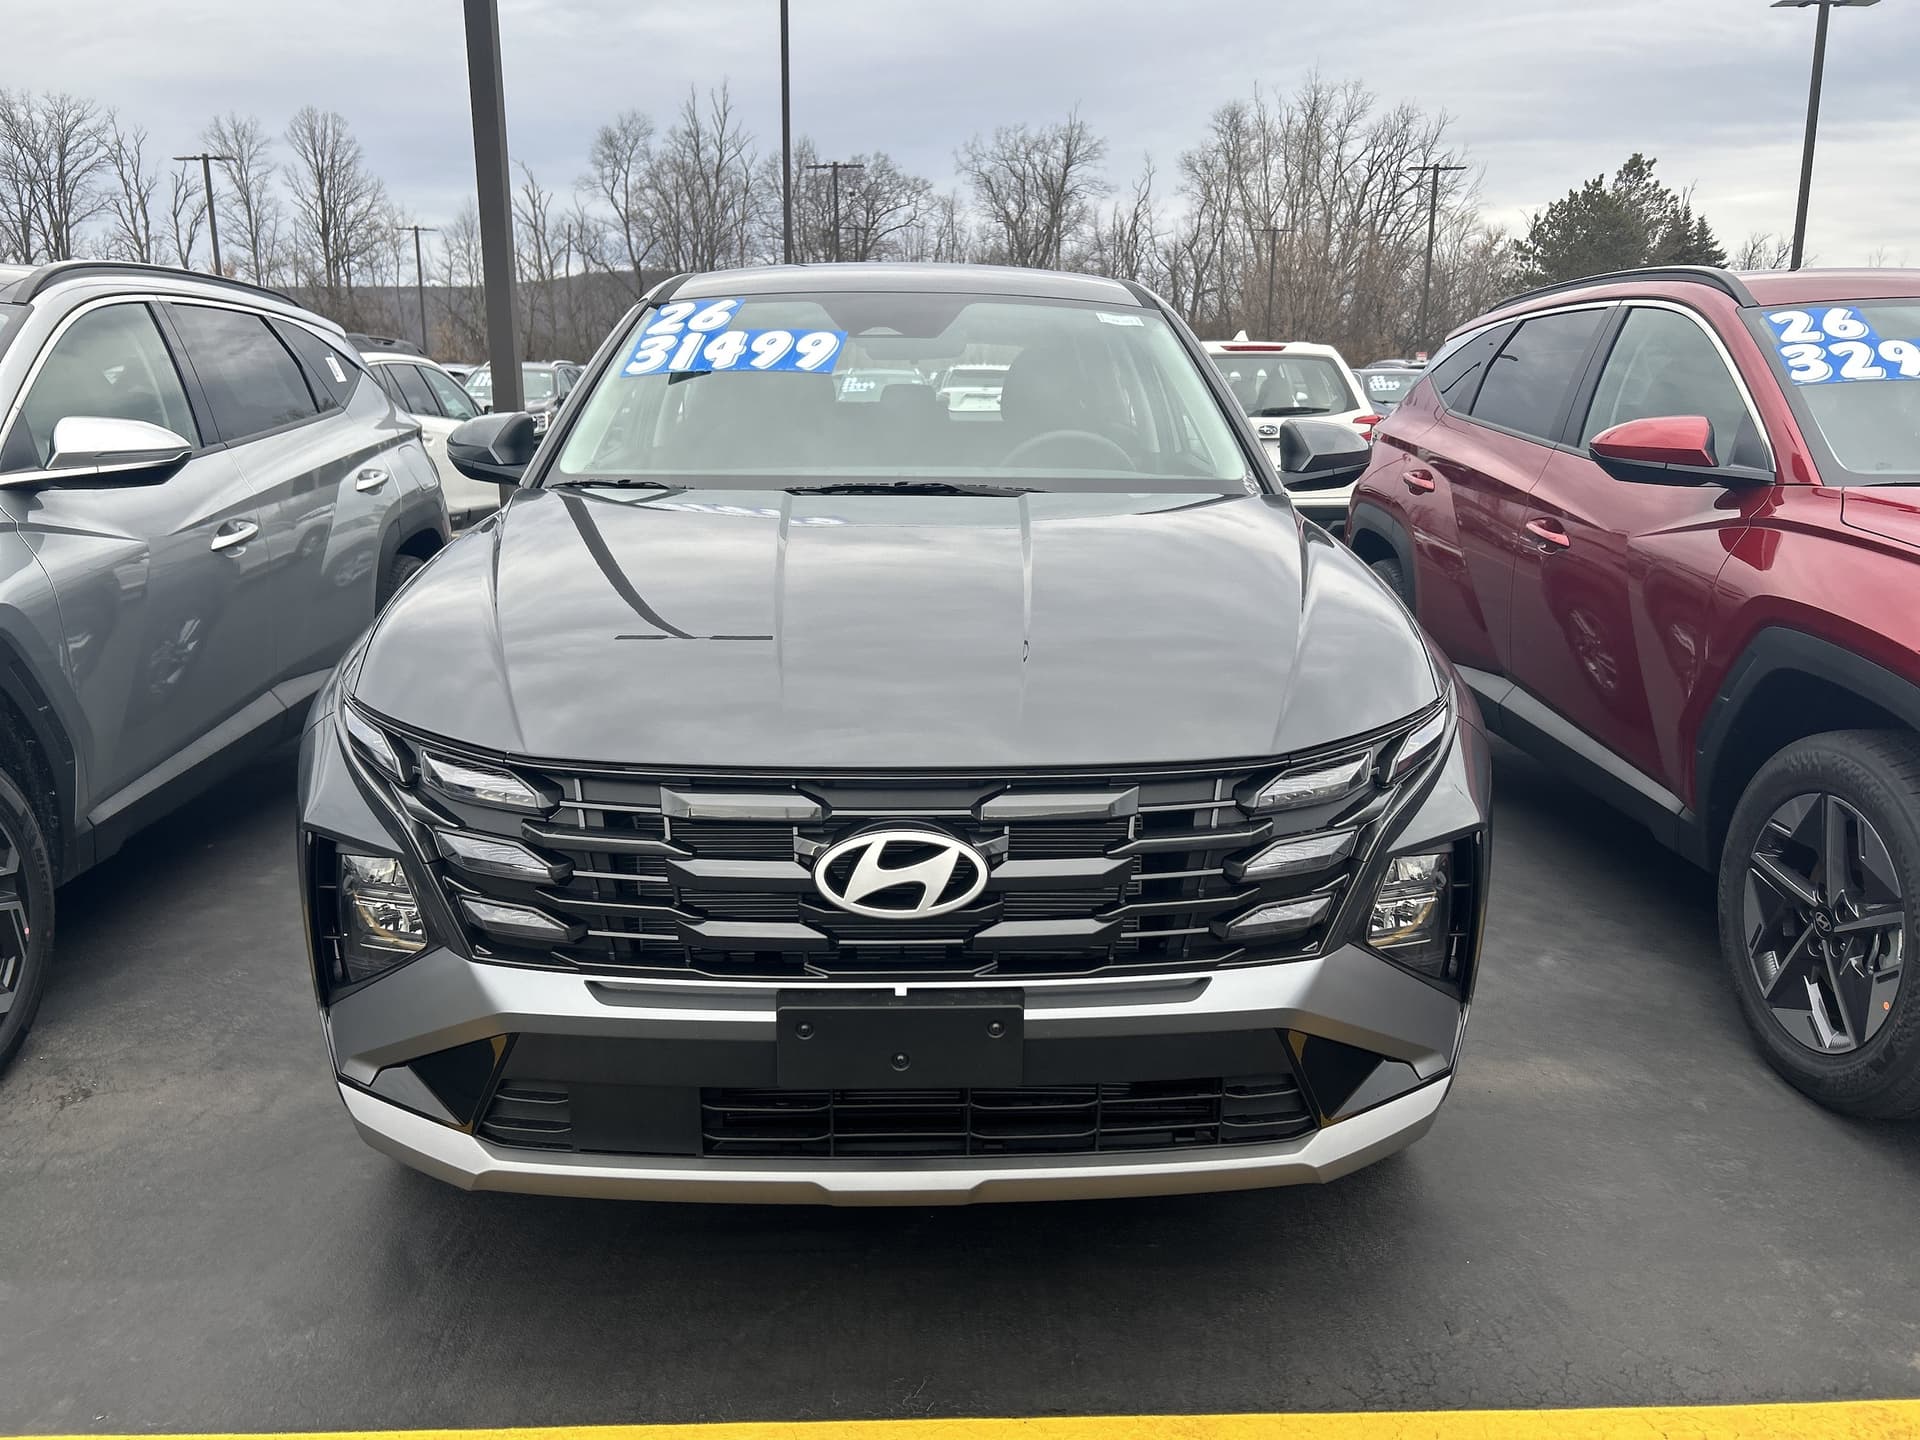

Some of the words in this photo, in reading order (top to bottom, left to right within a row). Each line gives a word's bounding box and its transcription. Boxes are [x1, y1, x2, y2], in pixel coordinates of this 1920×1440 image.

[646, 299, 738, 336] 26
[1769, 307, 1870, 343] 26
[625, 330, 841, 375] 31499
[1780, 339, 1920, 383] 329
